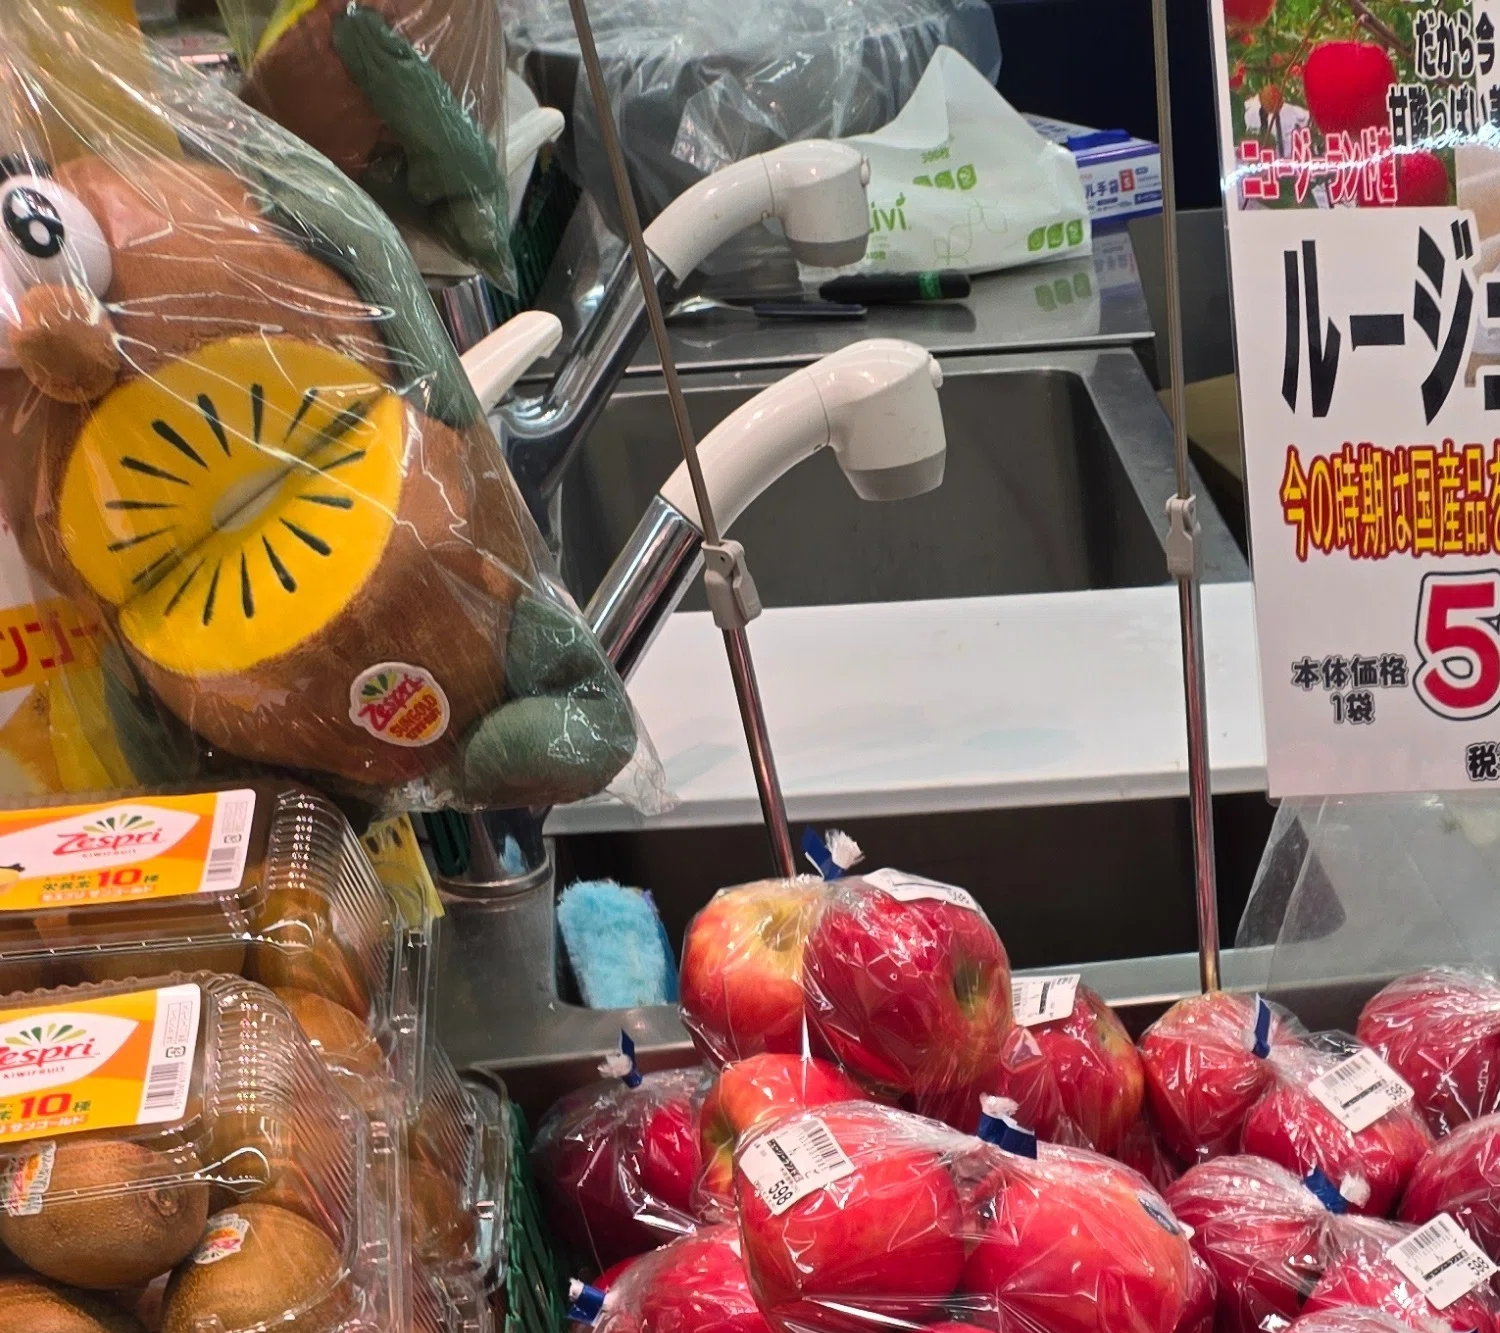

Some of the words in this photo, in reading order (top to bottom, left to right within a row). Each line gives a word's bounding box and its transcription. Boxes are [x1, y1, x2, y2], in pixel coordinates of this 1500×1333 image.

[1292, 654, 1407, 690] 本体価格
[358, 673, 426, 732] Zespri
[1331, 692, 1376, 724] 1袋
[53, 827, 163, 857] Zespri
[0, 1037, 96, 1070] espri
[1385, 1083, 1408, 1101] 598
[768, 1179, 793, 1206] 598
[1467, 1256, 1490, 1276] 598
